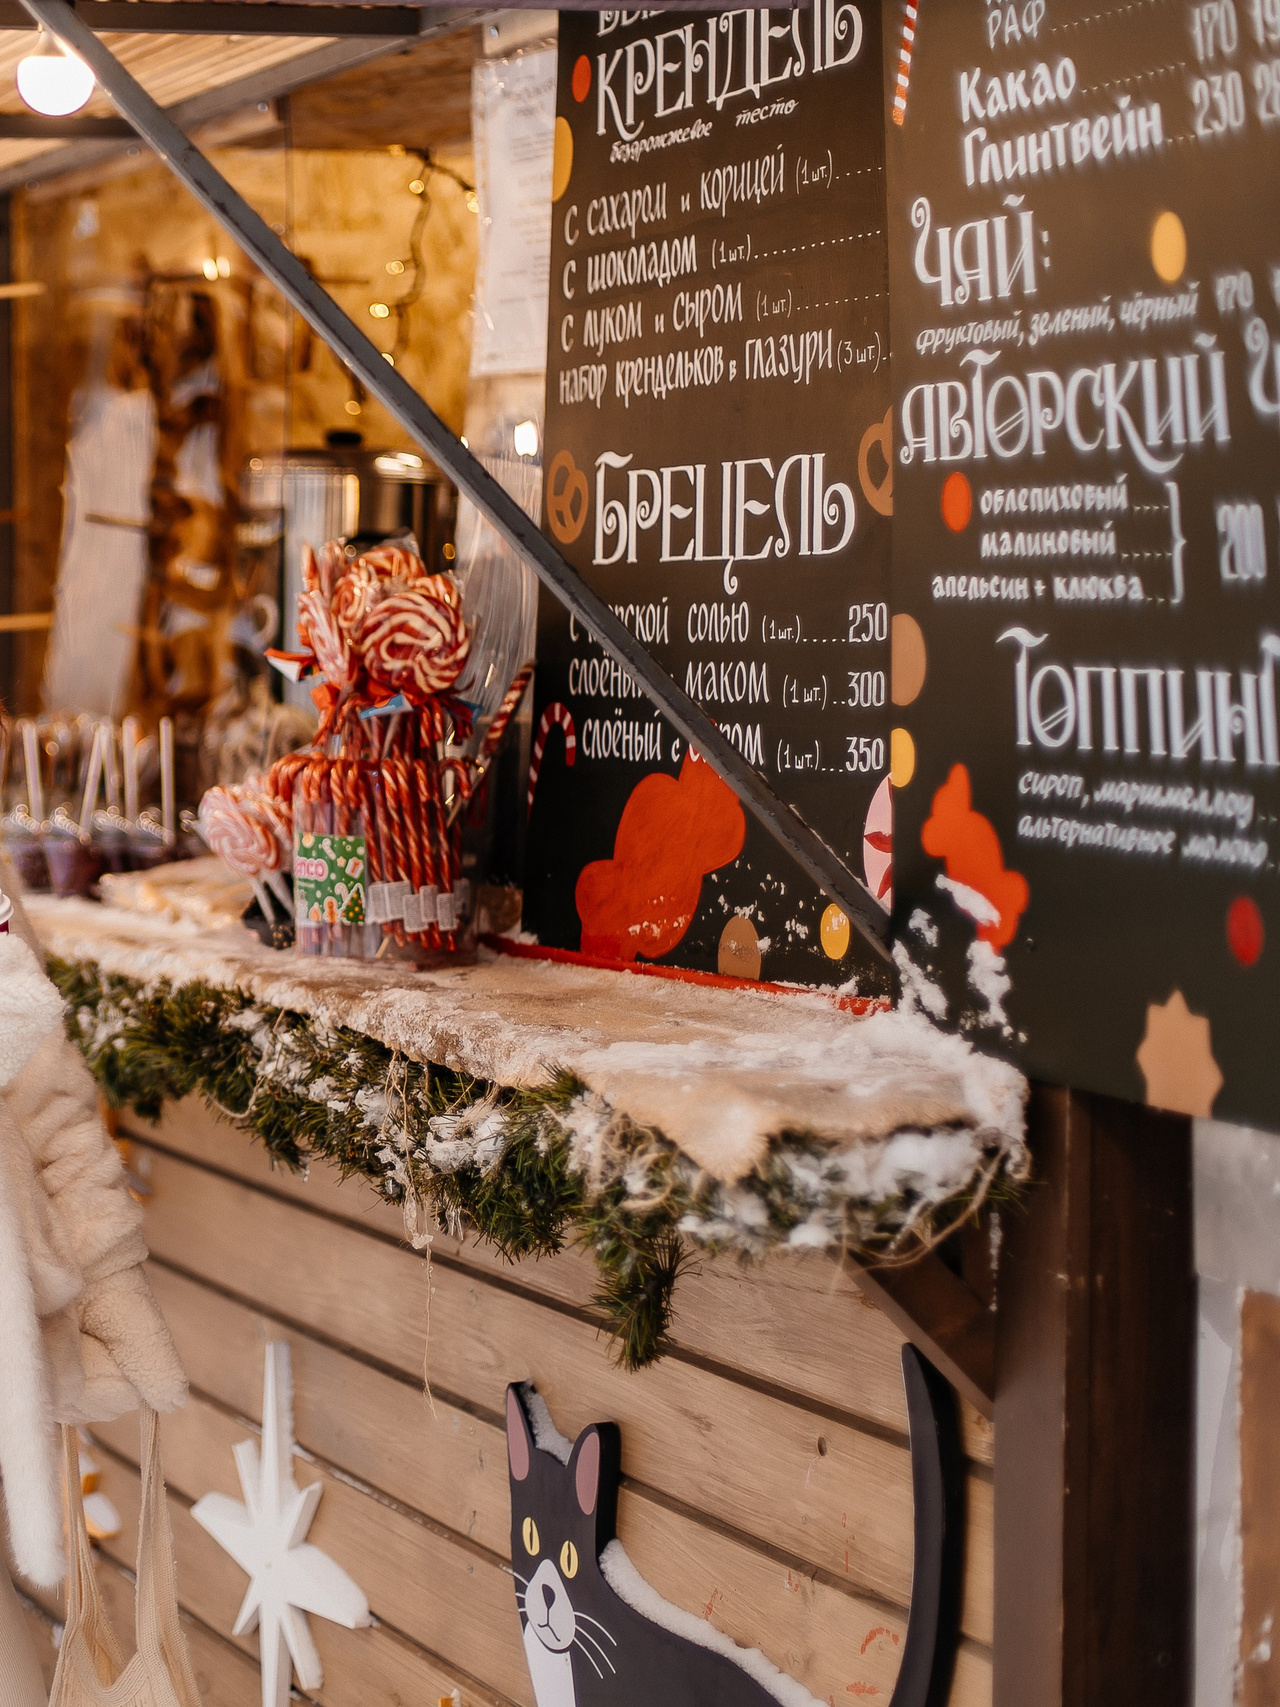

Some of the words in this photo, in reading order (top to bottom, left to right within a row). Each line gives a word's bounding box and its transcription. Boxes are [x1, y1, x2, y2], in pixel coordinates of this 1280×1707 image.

[959, 56, 1077, 124] Какао
[1192, 0, 1238, 62] 170
[986, 0, 1046, 49] РАФ
[596, 0, 863, 141] КРЕНДЕЛЬ
[735, 97, 800, 127] тесто
[963, 94, 1163, 187] Глинтвейн
[1192, 71, 1246, 136] 230
[911, 194, 1051, 306] ЧАЙ:
[900, 332, 1231, 474] АВТОРСКИЙ
[592, 451, 856, 596] БРЕЦЕЛЬ
[980, 520, 1117, 559] малиновый
[848, 602, 888, 643] 250
[847, 670, 885, 708] 300
[845, 736, 884, 773] 350
